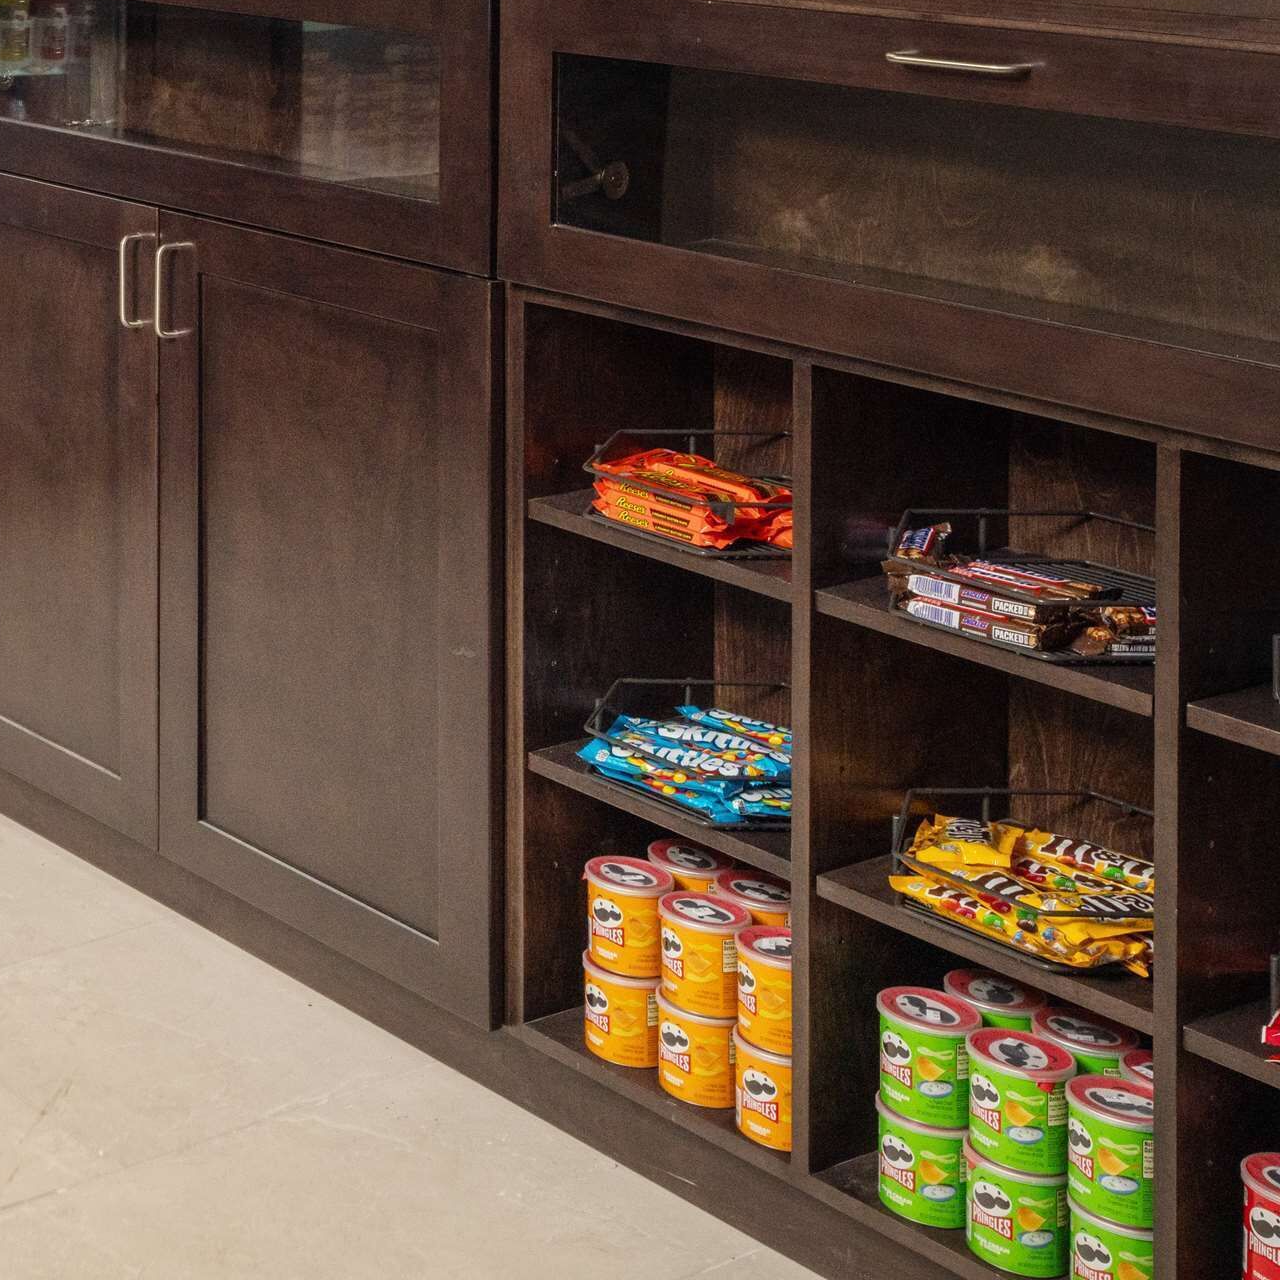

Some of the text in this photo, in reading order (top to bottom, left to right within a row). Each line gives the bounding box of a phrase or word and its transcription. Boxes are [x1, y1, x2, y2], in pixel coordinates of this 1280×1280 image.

[994, 599, 1022, 616] PACKED
[994, 627, 1022, 644] PACKED
[592, 923, 624, 946] PRINGLES
[660, 1042, 690, 1073] PRINGLES
[742, 1089, 778, 1122] PRINGLES
[880, 1156, 916, 1193] PRINGLES
[972, 1203, 1013, 1239] PRINGLES
